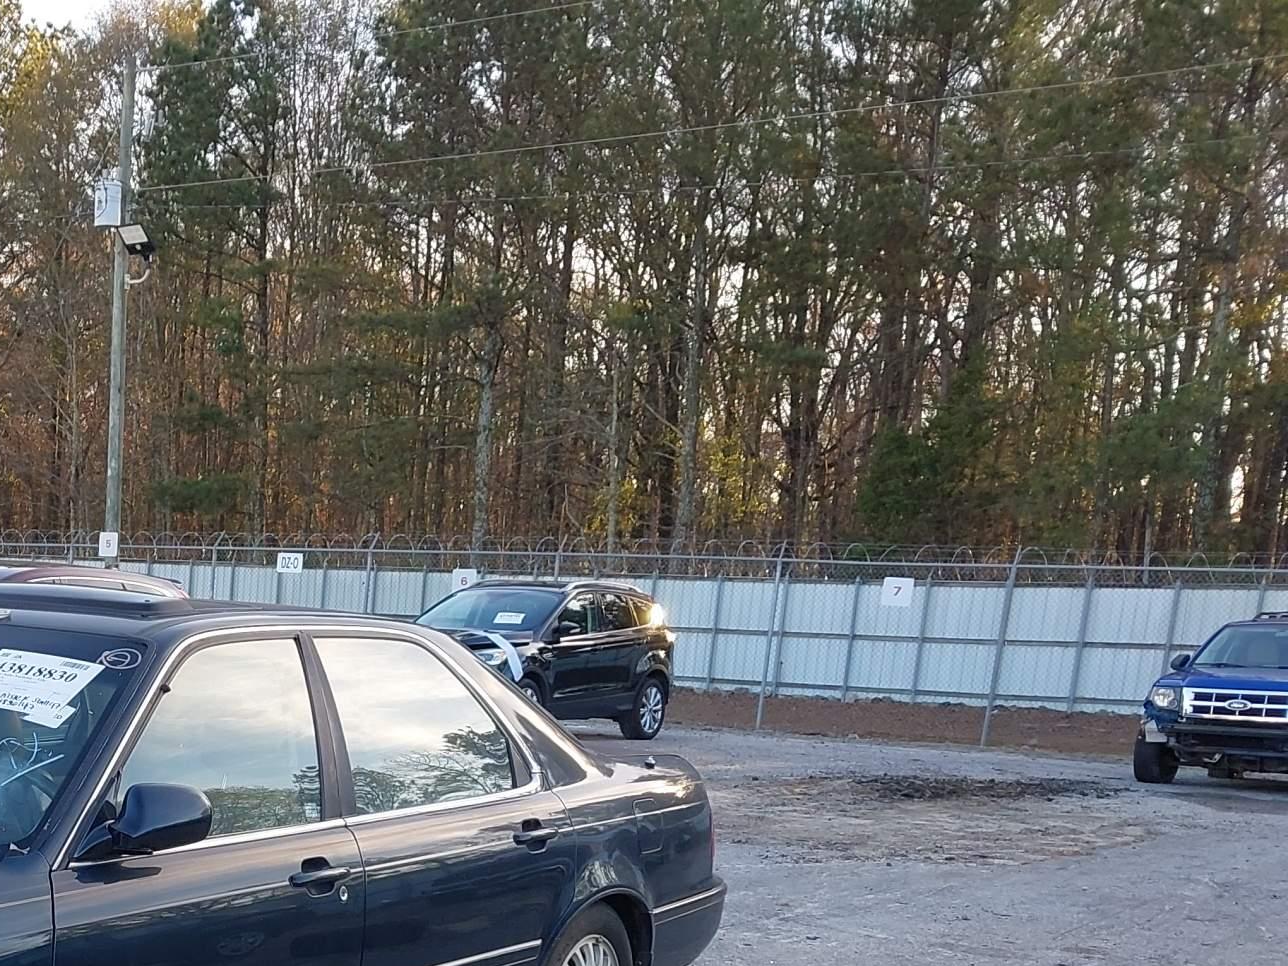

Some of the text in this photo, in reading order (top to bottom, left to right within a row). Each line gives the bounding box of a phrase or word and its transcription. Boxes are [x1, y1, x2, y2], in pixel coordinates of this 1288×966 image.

[105, 539, 112, 548] 5
[460, 576, 468, 586] 6
[893, 585, 903, 597] 7
